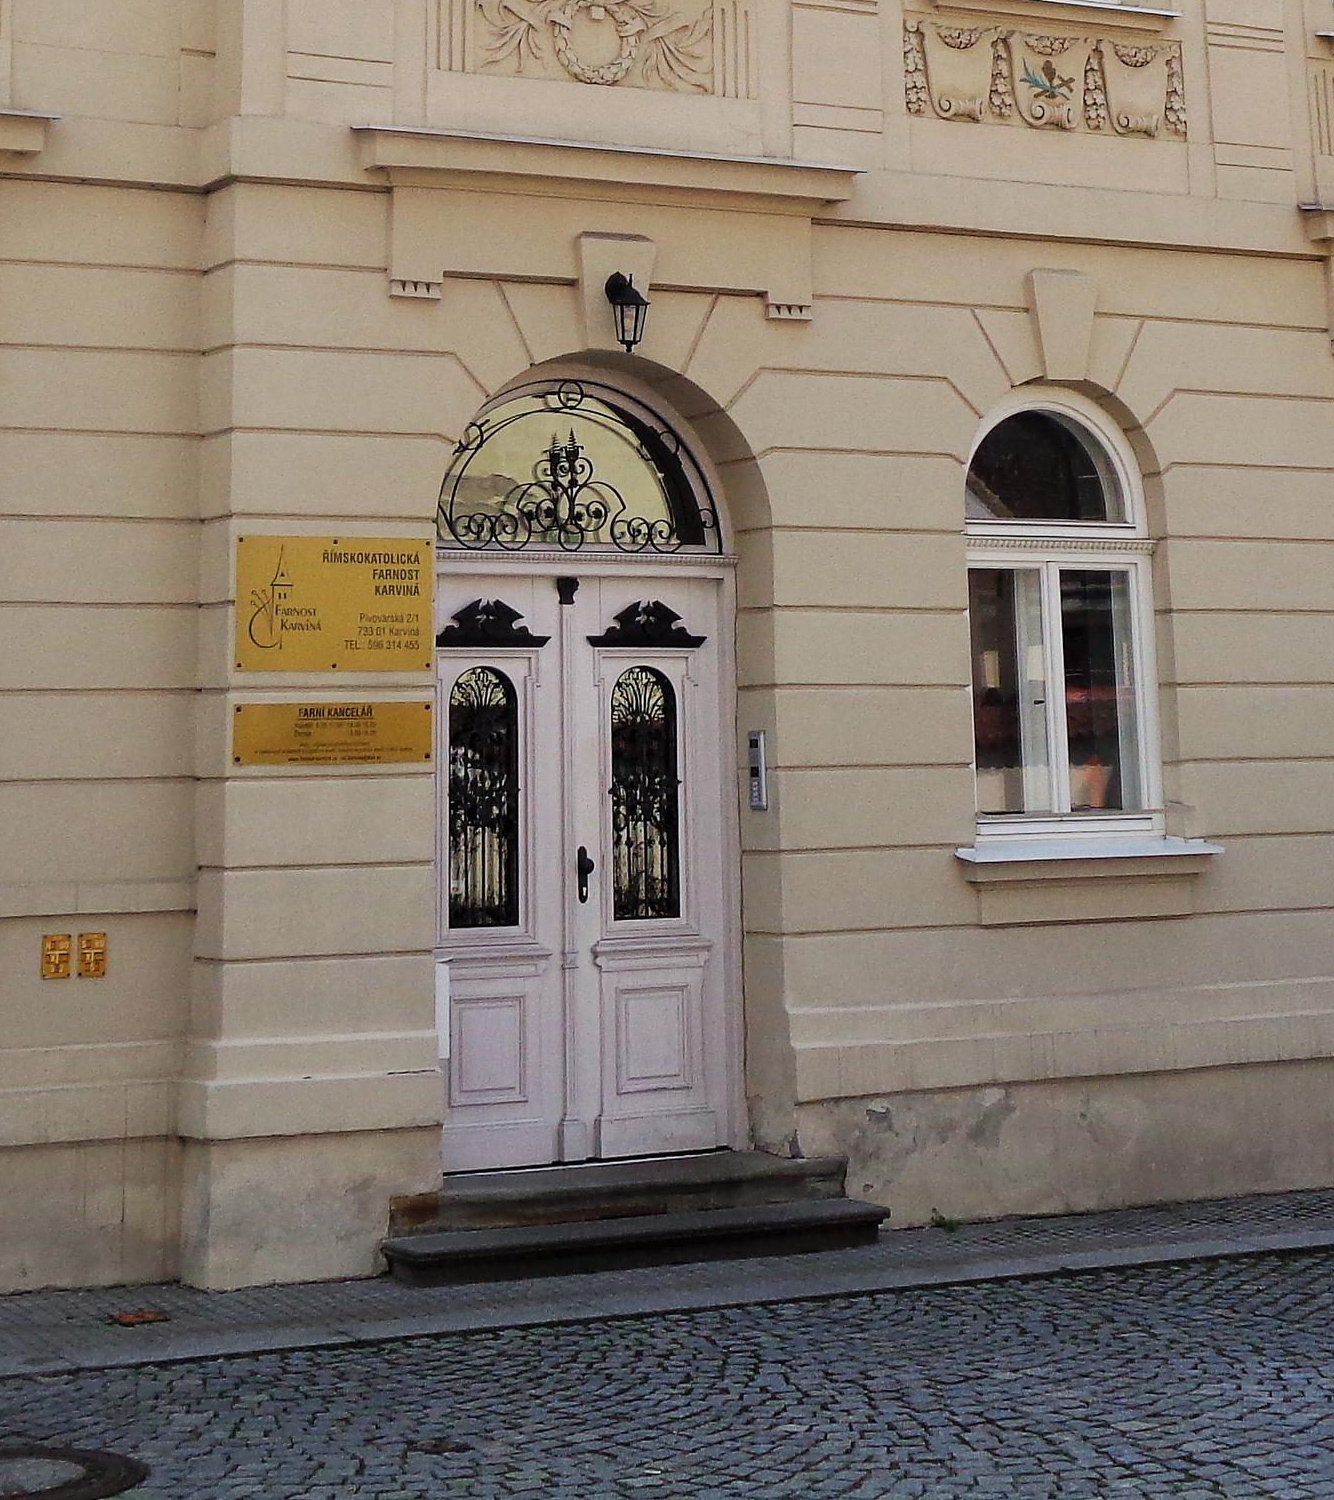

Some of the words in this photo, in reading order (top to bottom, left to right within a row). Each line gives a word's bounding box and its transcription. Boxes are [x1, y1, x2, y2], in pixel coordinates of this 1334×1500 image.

[322, 549, 420, 564] ŘÍMSKOKATOLICKÁ
[372, 568, 420, 580] FARNOST
[374, 582, 420, 596] KARVINÁ
[275, 603, 316, 617] FARNOST
[298, 706, 326, 718] FARNÍ
[327, 705, 373, 718] KANCELÁŘ
